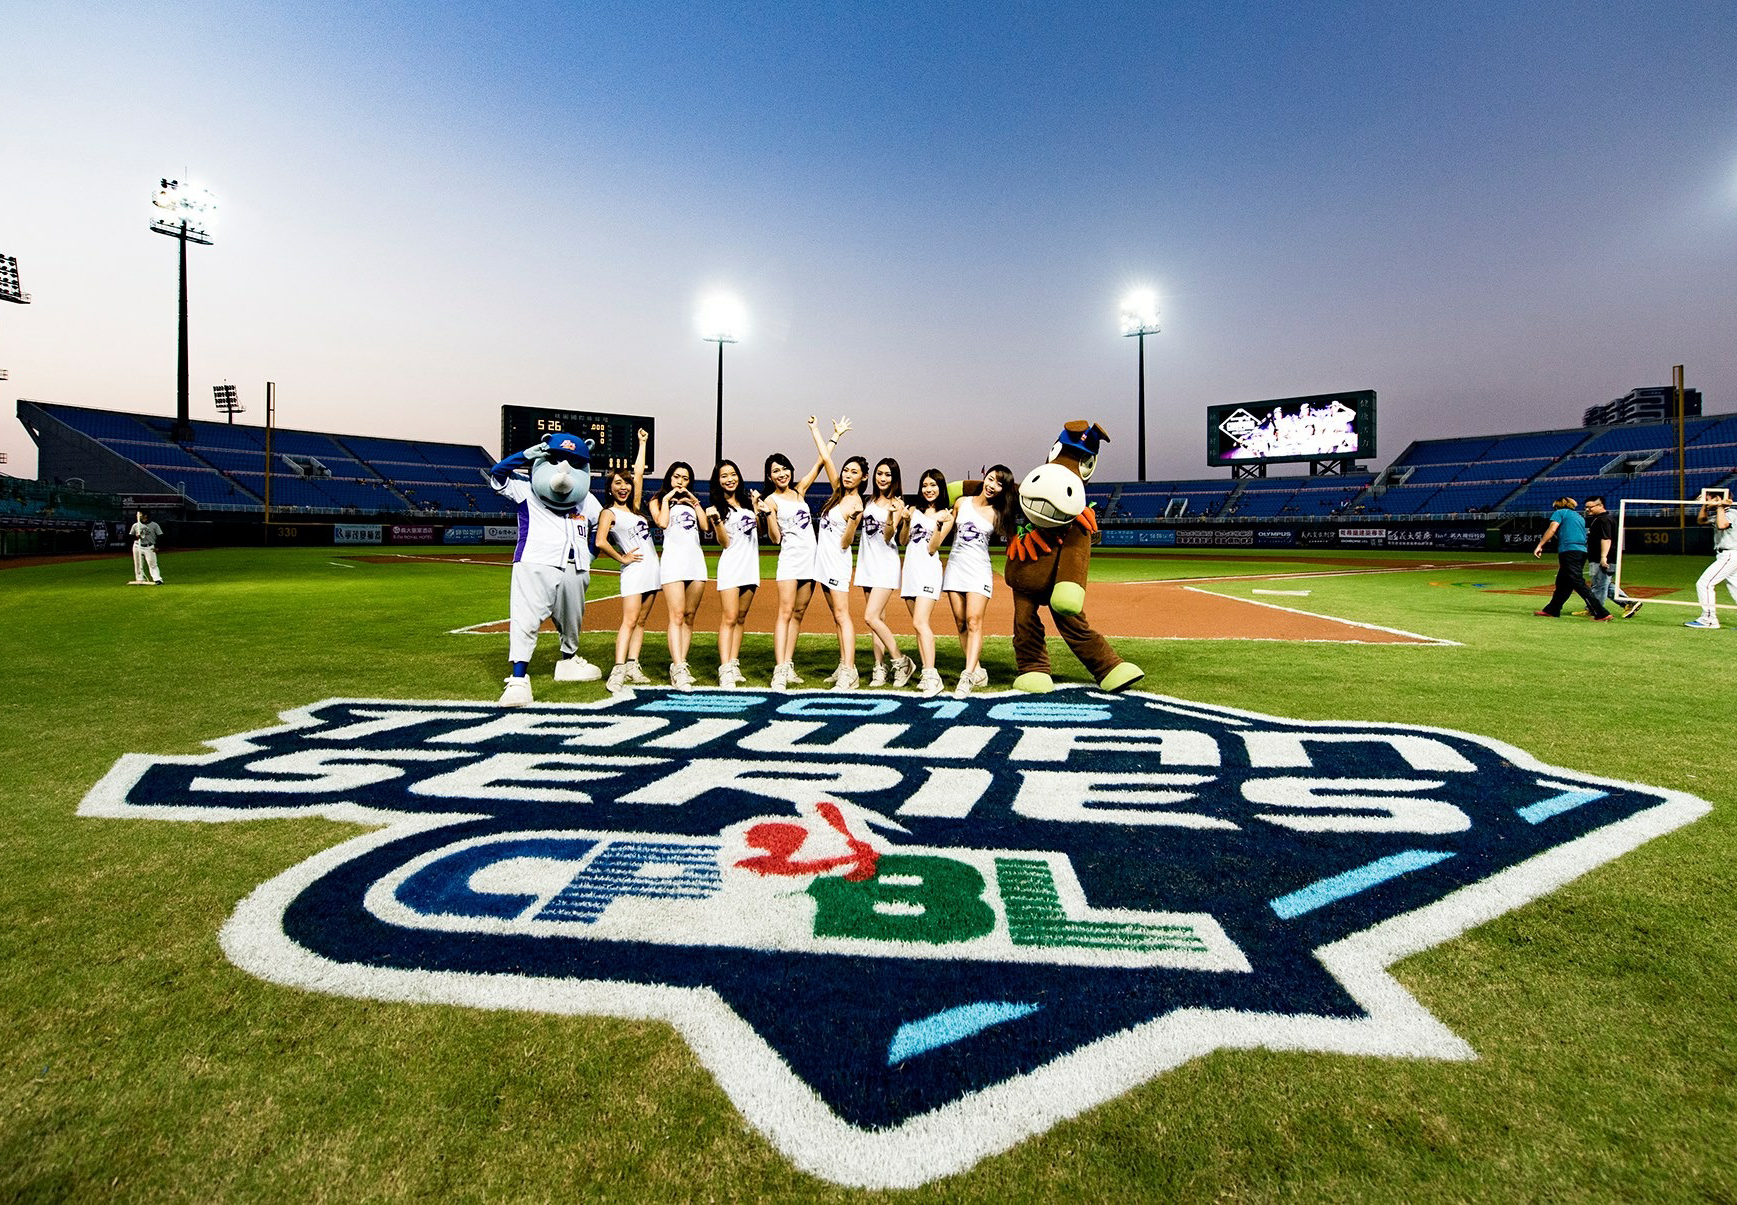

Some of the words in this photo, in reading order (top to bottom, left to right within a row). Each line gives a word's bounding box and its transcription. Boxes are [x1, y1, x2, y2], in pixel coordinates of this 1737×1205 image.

[537, 419, 545, 430] 5
[547, 420, 562, 432] 26
[278, 527, 297, 538] 330
[1644, 532, 1669, 544] 330
[635, 693, 1112, 722] 2016
[298, 708, 1479, 774] TAIWAN
[190, 748, 1473, 834] SERIES
[393, 836, 1209, 955] CPBL
